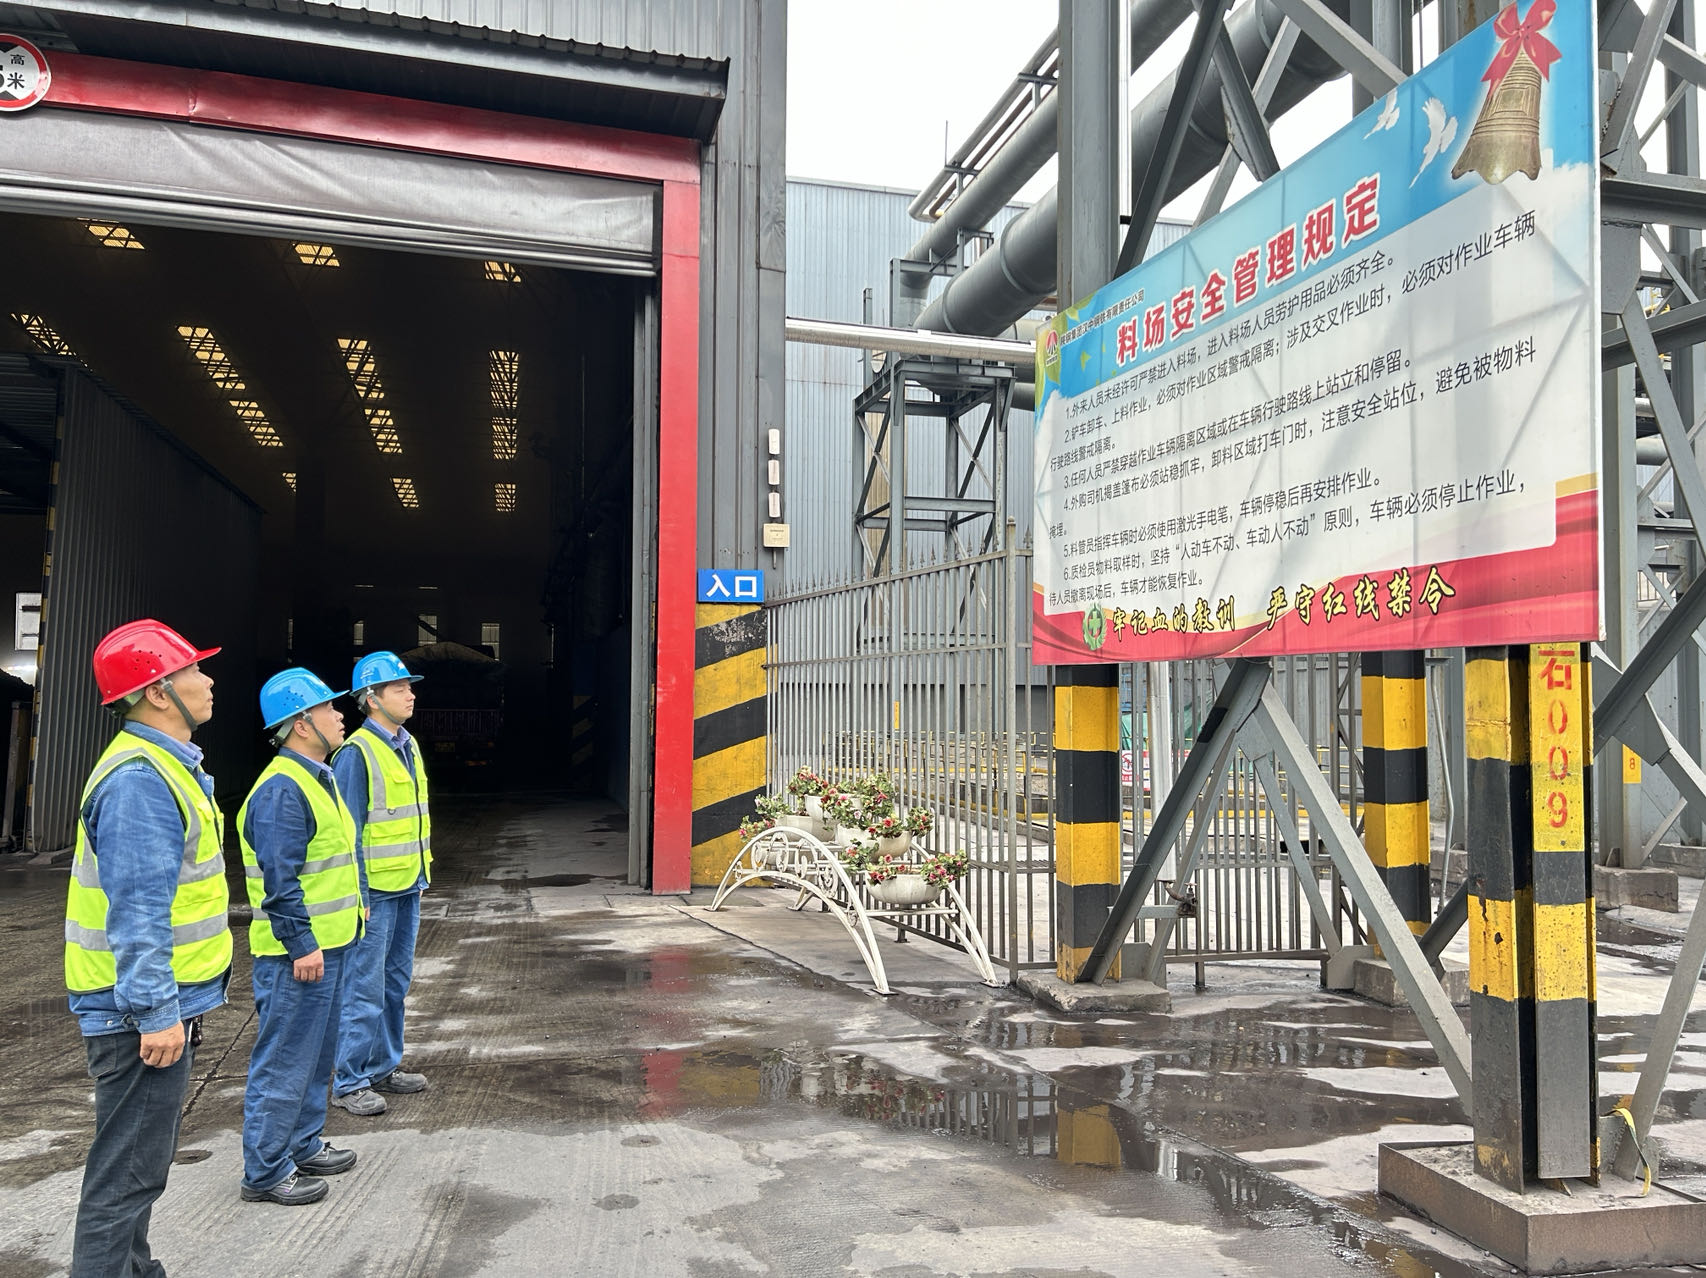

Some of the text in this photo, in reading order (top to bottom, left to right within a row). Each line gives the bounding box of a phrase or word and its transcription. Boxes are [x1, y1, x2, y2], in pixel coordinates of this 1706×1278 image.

[10, 54, 25, 65] 高
[1117, 175, 1379, 364] 料场安全管理规定
[706, 573, 757, 598] 入口
[1113, 565, 1455, 641] 牢记血的教训 严守红线禁令
